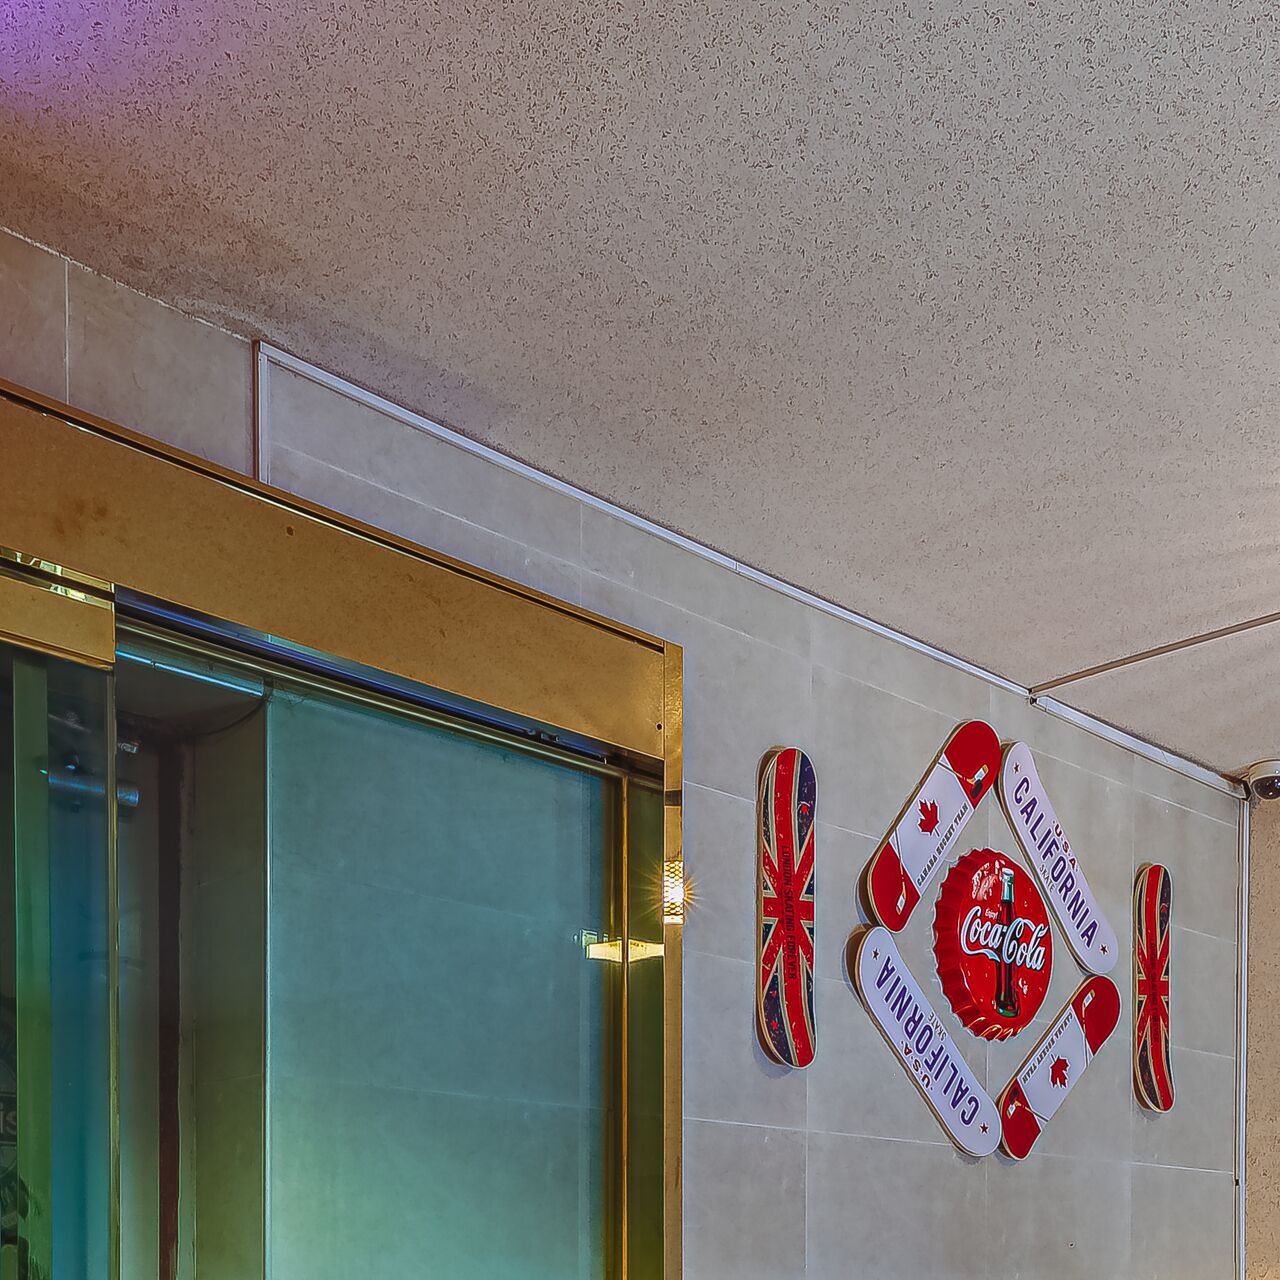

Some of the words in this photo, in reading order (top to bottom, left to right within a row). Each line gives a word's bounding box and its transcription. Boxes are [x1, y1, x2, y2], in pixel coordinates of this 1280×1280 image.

[1013, 776, 1099, 949] CALIFORNIA
[1039, 864, 1056, 893] SKATE
[960, 905, 1049, 971] Coca-Cola
[876, 956, 980, 1126] CALIFORNIA
[927, 1011, 947, 1042] SKATE
